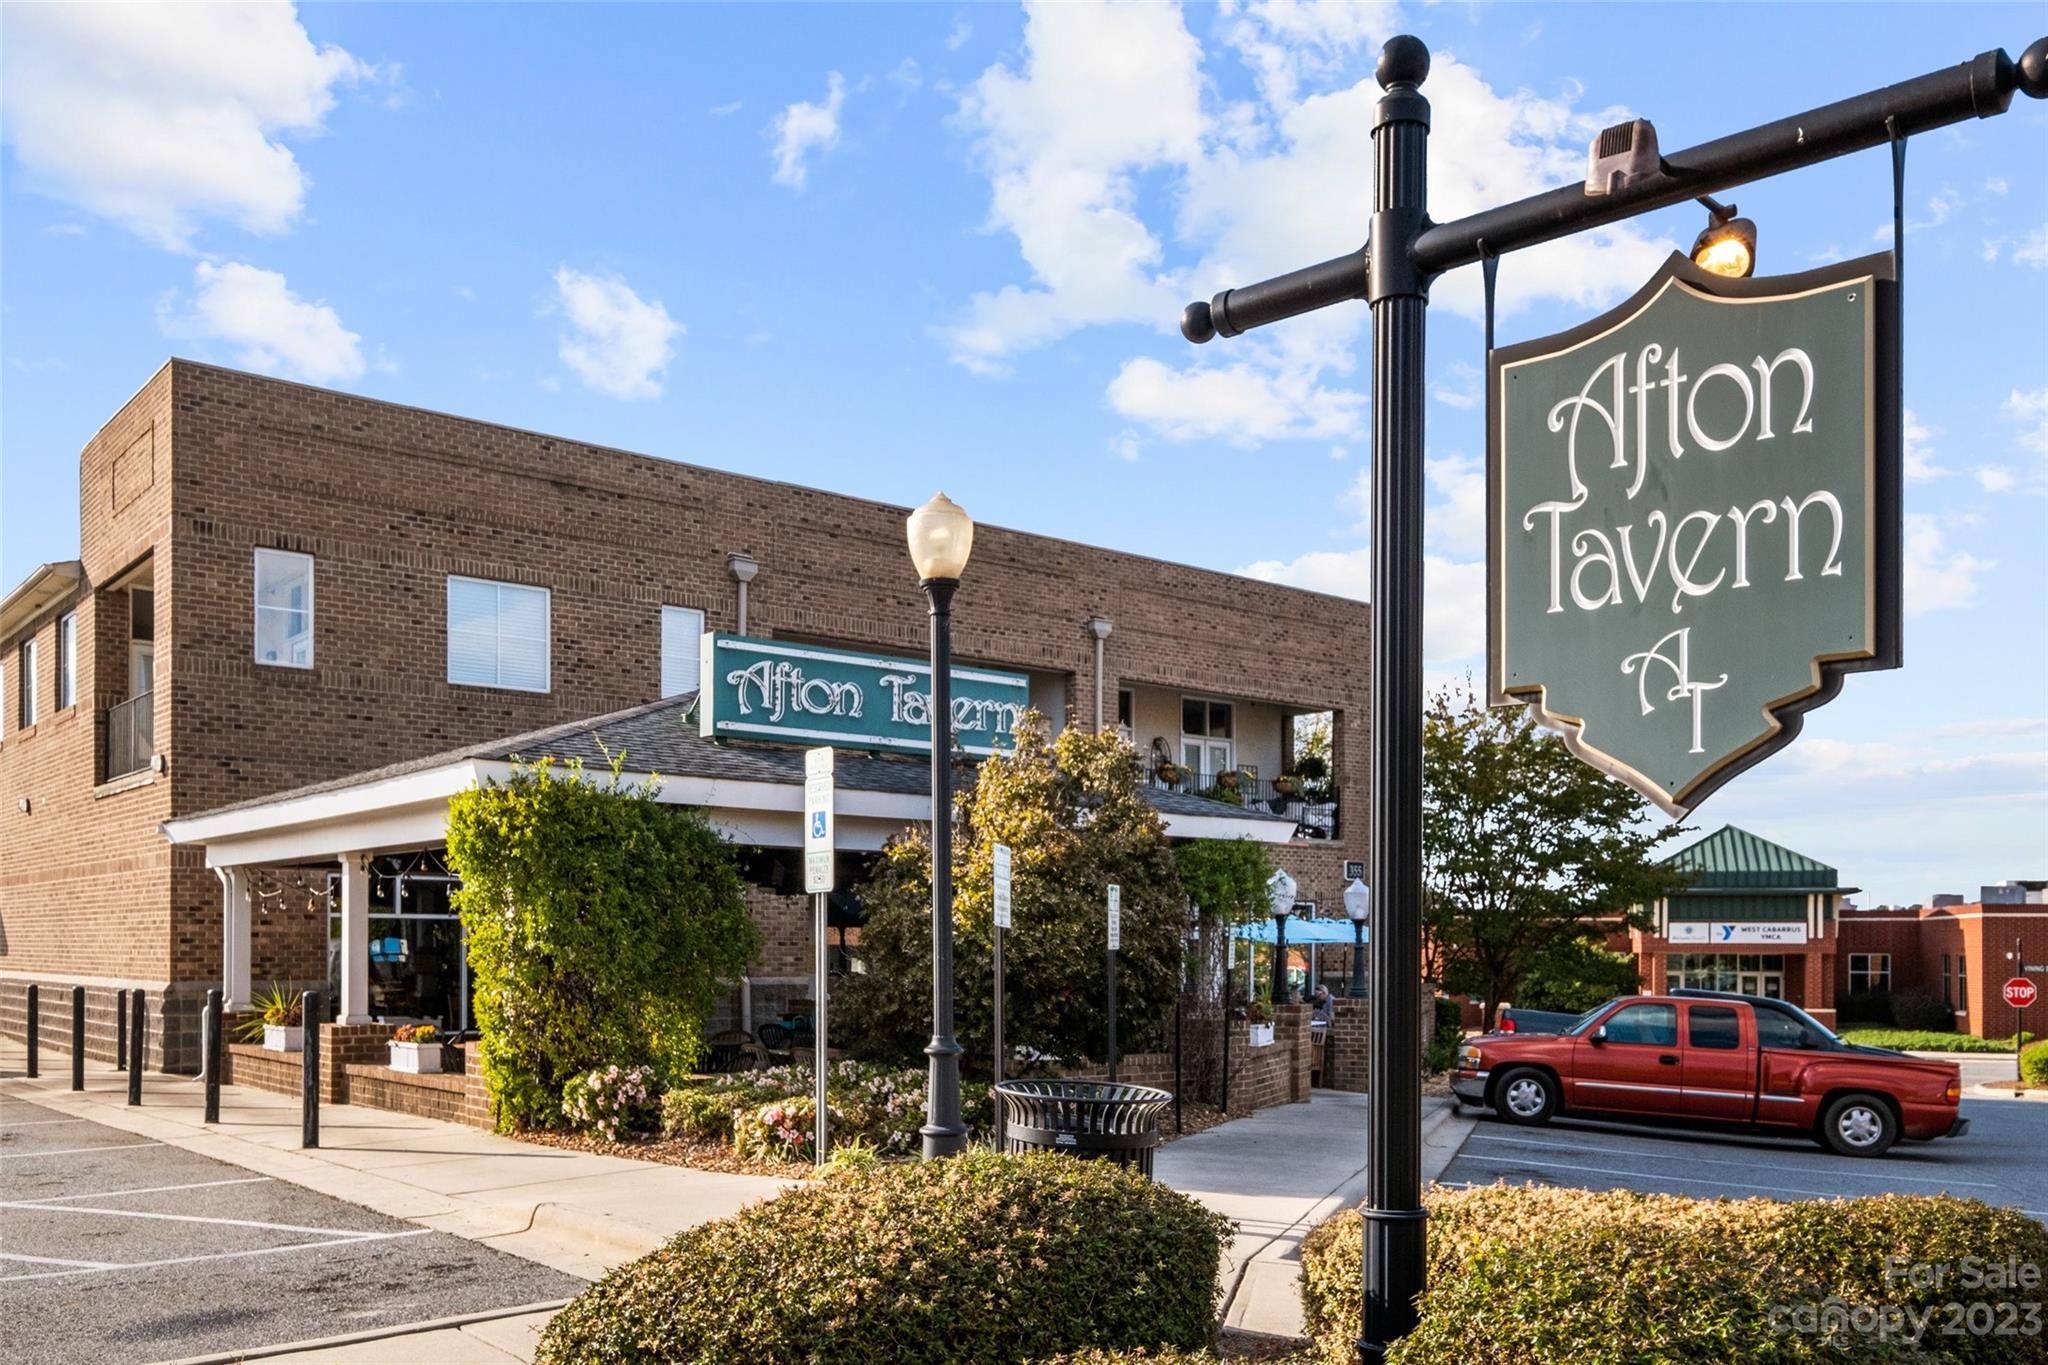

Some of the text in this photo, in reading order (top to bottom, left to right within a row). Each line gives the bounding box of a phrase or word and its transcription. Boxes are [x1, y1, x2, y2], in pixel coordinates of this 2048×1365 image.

[1546, 343, 1814, 499] Afton
[1523, 487, 1843, 613] Tavern
[727, 661, 1020, 734] Afton Taern
[2006, 986, 2034, 998] STOP
